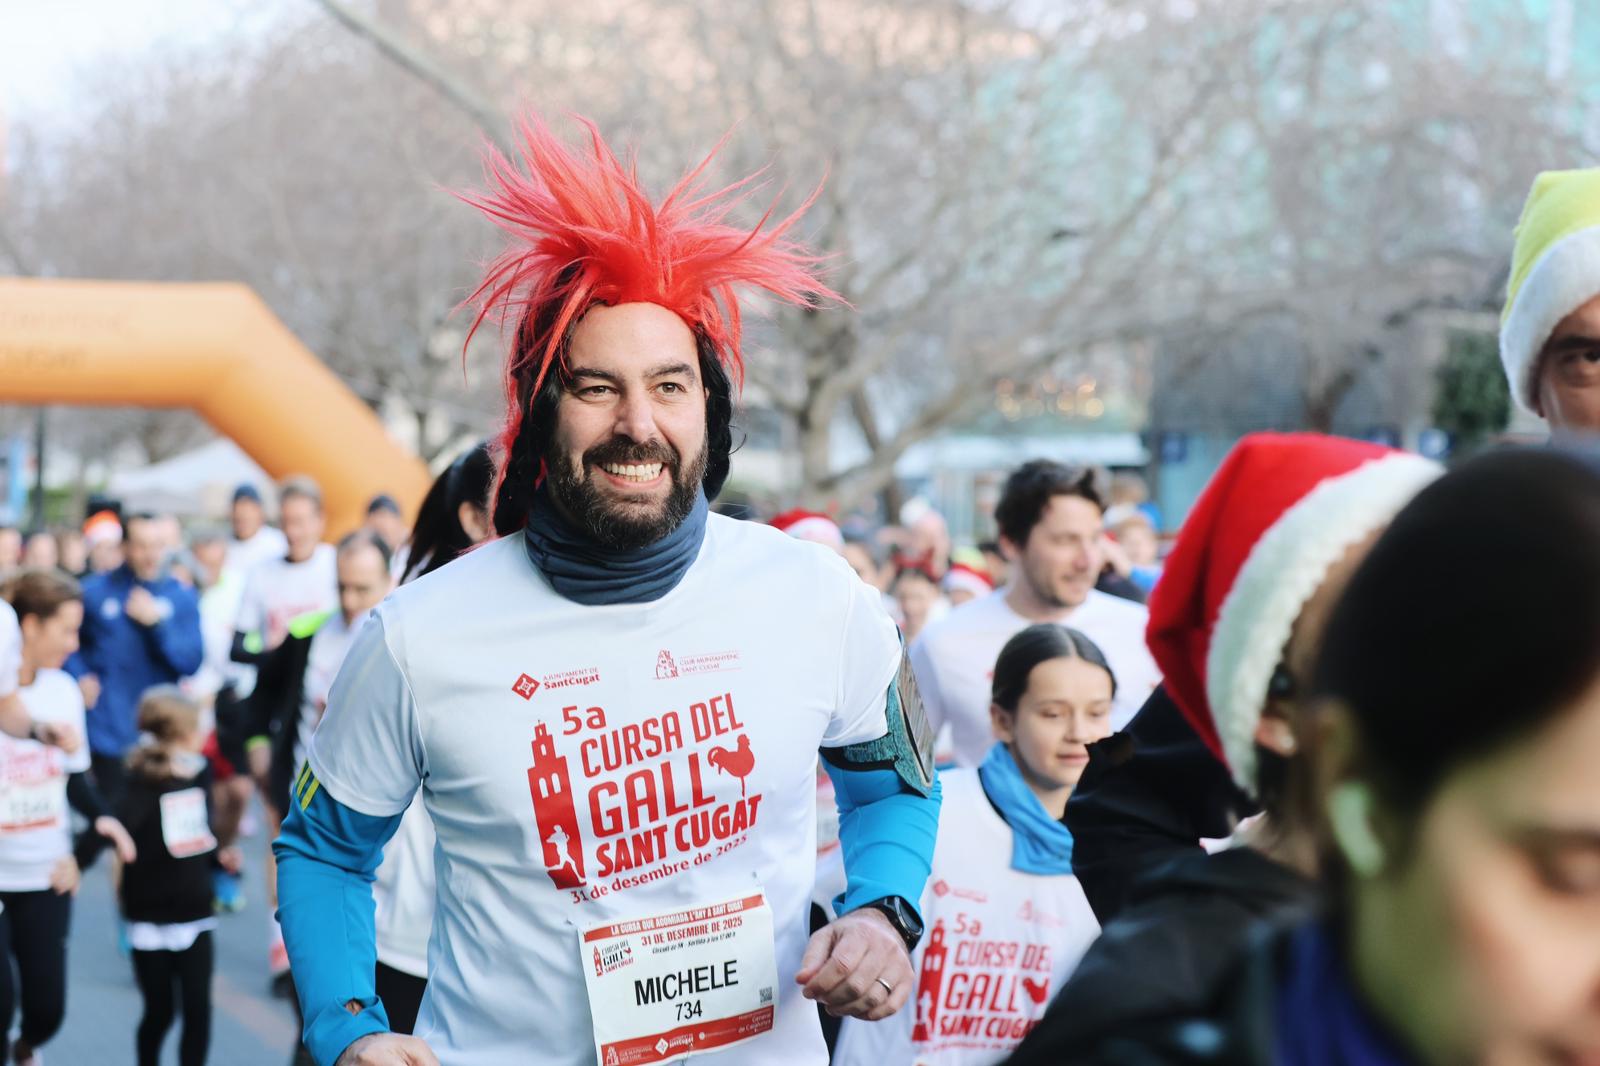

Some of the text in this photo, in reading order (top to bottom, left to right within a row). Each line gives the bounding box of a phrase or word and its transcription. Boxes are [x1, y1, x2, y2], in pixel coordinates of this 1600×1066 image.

[543, 666, 599, 681] AJUNTAMENT DE
[544, 674, 601, 690] SantCugat
[561, 704, 607, 736] 5a
[580, 692, 745, 779] CURSA DEL
[587, 752, 716, 838] GALL
[596, 794, 762, 878] SANT CUGAT
[570, 833, 748, 905] 31 de desembre de 2025
[610, 925, 620, 937] LA
[642, 918, 654, 932] QUE
[641, 916, 743, 946] 31 DE DESEMBRE DE 2025
[954, 912, 982, 937] 5a
[954, 940, 1051, 973] CURSA DE
[634, 959, 739, 1006] MICHELE
[944, 972, 1019, 1013] GALL
[675, 999, 703, 1022] 734
[940, 1014, 1040, 1040] SANT CUGA
